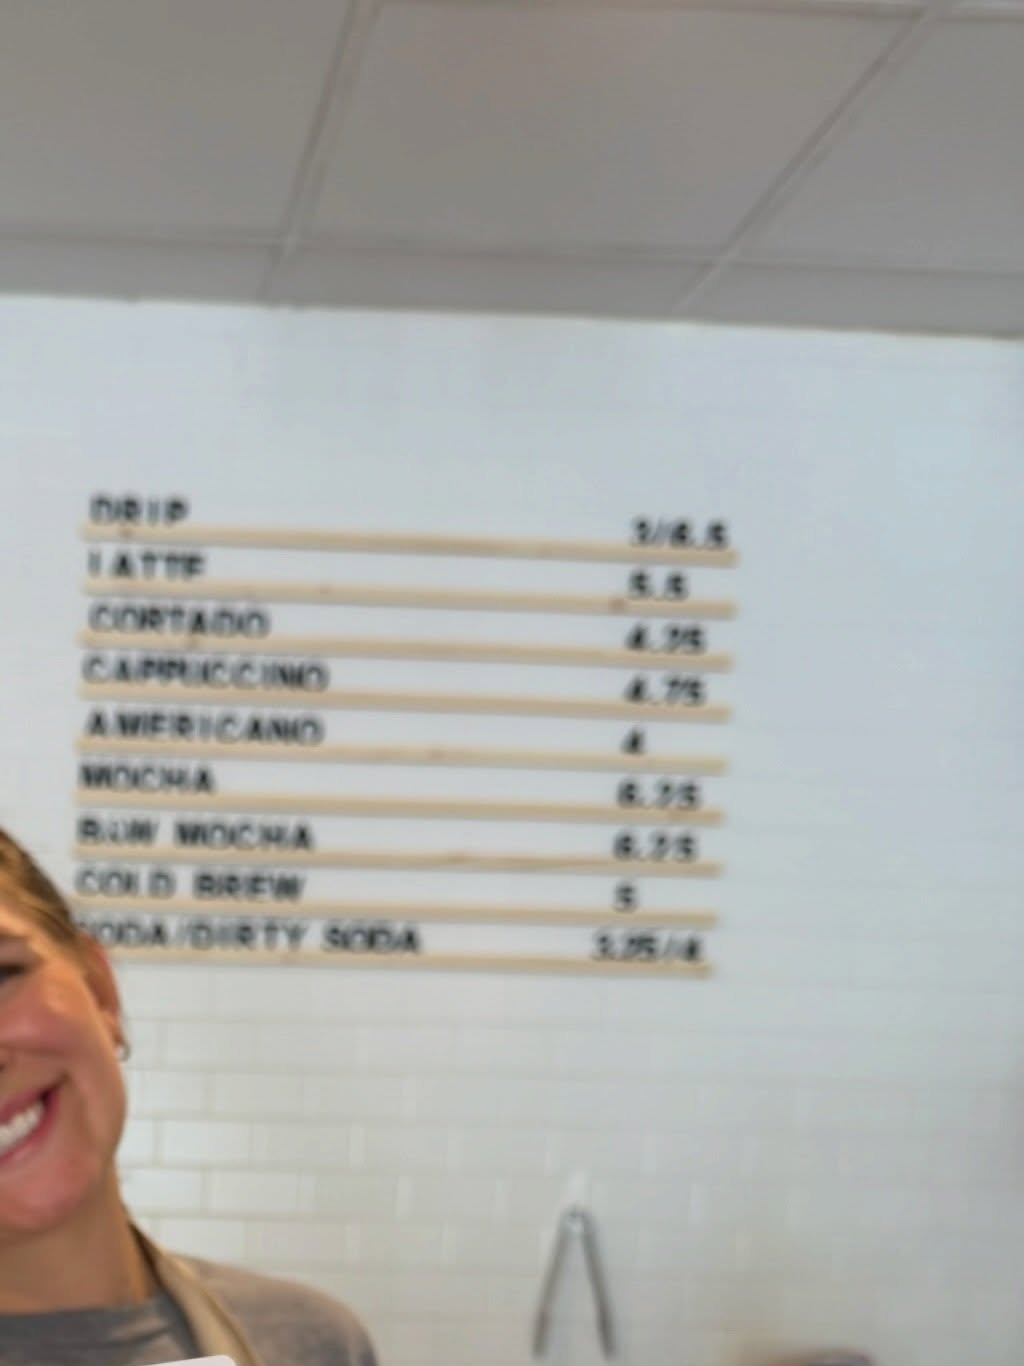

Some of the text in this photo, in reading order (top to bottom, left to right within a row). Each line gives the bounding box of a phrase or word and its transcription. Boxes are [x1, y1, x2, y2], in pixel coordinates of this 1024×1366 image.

[89, 493, 189, 526] DRIP
[88, 549, 204, 581] LATTE
[88, 601, 270, 639] CORTADO
[81, 654, 706, 706] CAPPUCCINO 4.75
[87, 708, 645, 755] AMERICANO 4
[77, 760, 215, 794] MOCHA
[173, 818, 315, 852] MOCHA
[73, 866, 640, 914] COLD BREW 5
[322, 917, 422, 955] SODA
